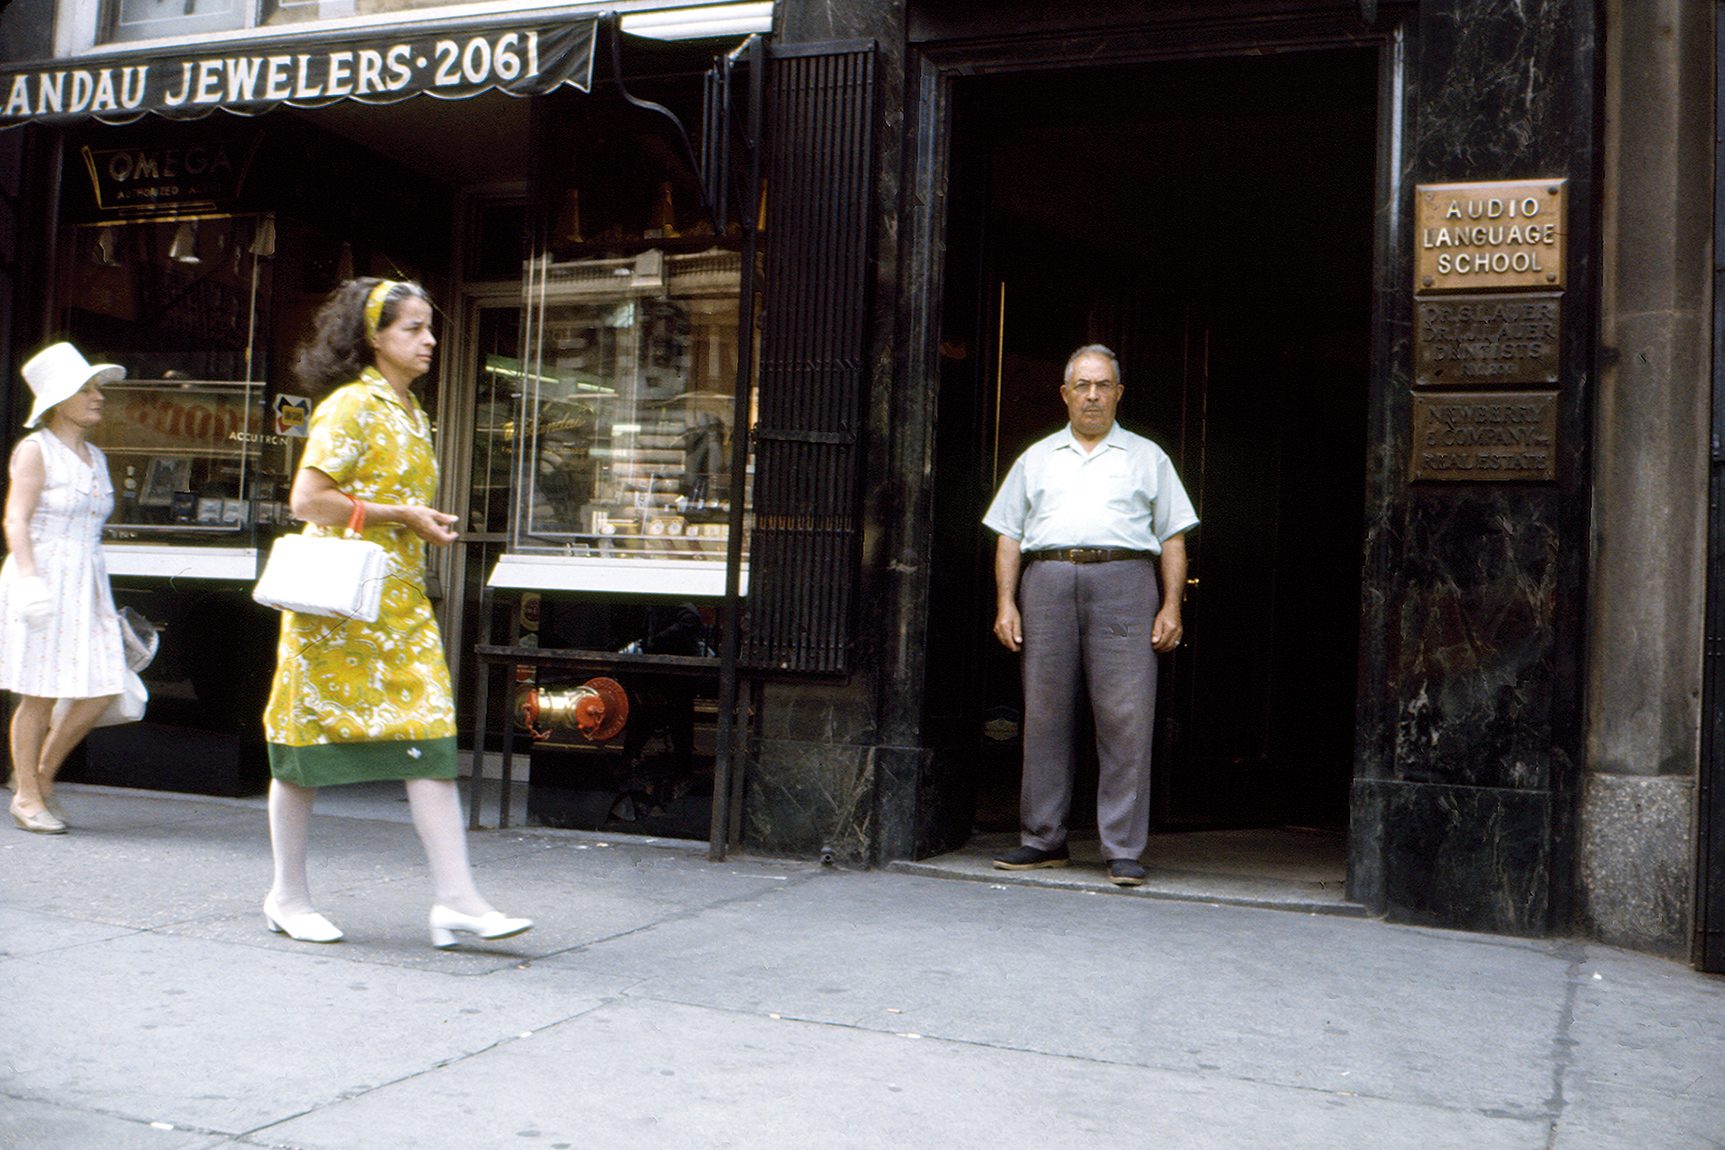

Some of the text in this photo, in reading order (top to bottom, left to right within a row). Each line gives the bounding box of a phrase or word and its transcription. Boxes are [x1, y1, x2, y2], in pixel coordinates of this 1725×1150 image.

[0, 31, 539, 116] ANDAU JEWELERS 2061
[108, 146, 232, 183] OMEGA
[1445, 197, 1539, 220] AUDIO
[1423, 223, 1555, 248] LANGUAGE
[1437, 252, 1543, 274] SCHOOL
[1442, 426, 1535, 446] COMPANY
[1476, 451, 1547, 471] ESTATE
